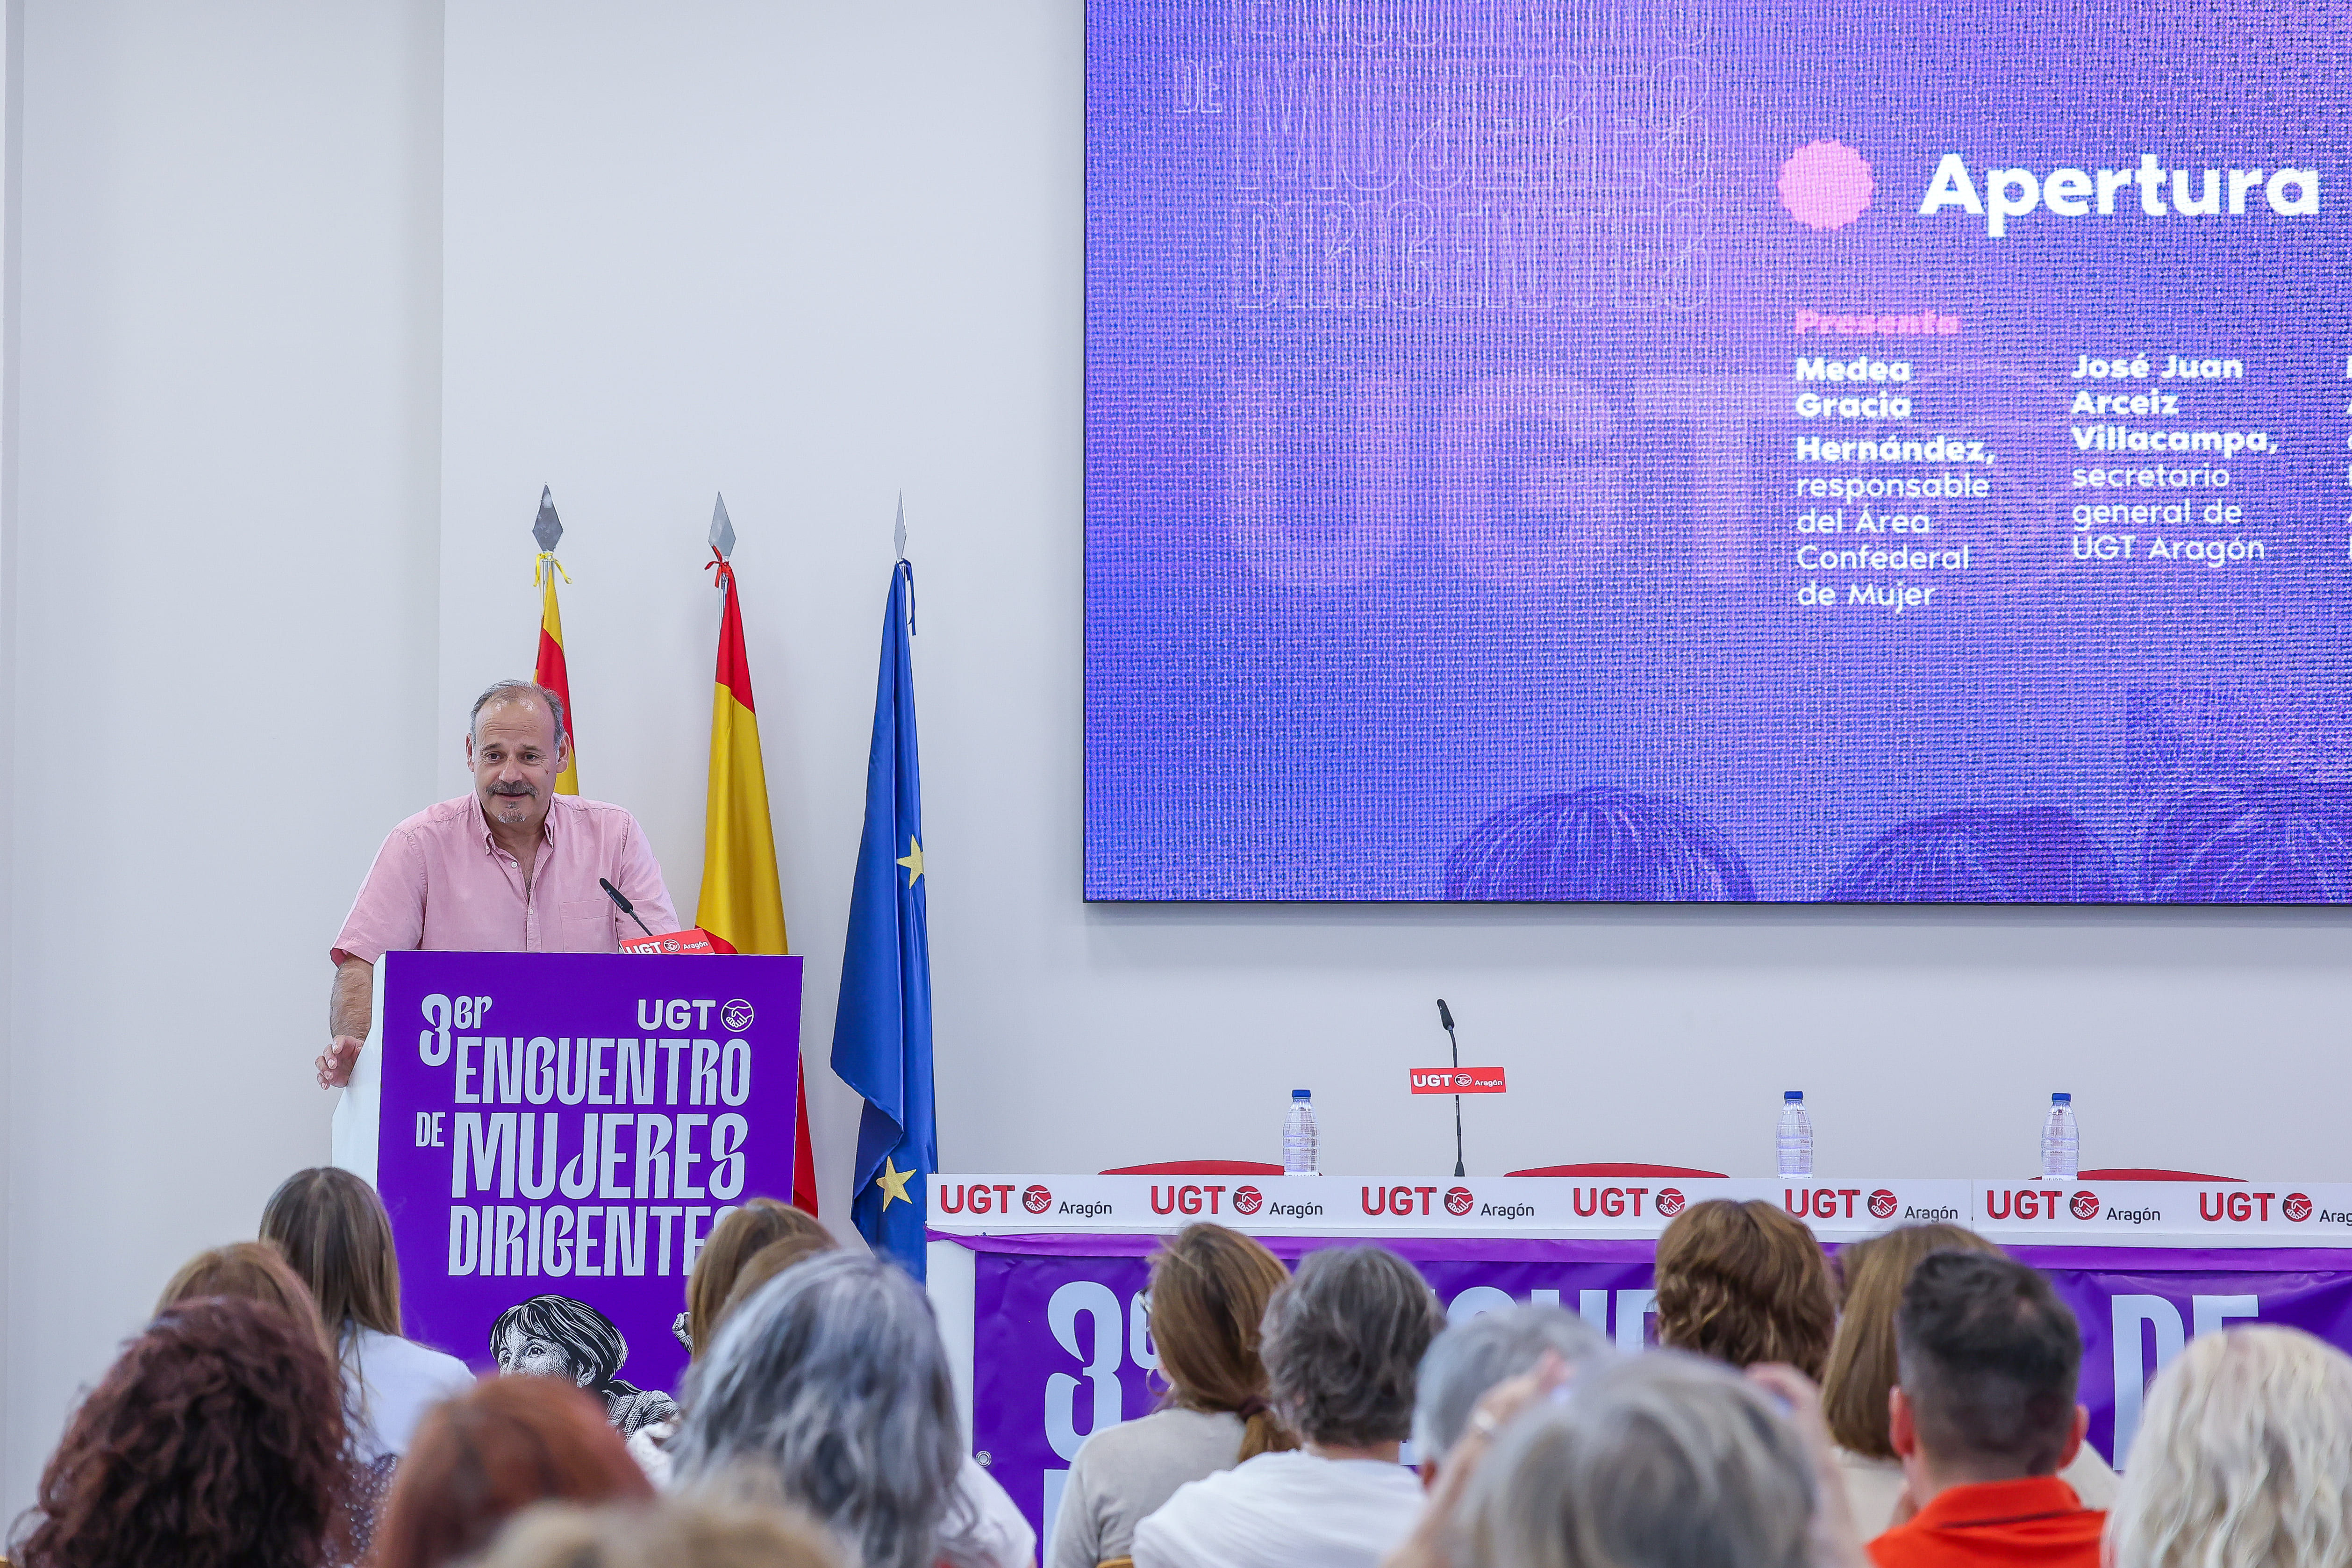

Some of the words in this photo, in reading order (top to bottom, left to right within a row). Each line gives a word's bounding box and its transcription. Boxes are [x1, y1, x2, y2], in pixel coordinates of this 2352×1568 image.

[1176, 59, 1222, 113] DE
[1236, 57, 1710, 191] MUJERES
[1918, 153, 2319, 238] Apertura
[1235, 200, 1710, 309] DIRIGENTES
[1794, 310, 1960, 335] Presenta
[1795, 355, 1911, 382] Medea
[2071, 352, 2150, 379] José
[2161, 354, 2244, 379] Juan
[1794, 389, 1912, 419] Gracia
[2070, 387, 2180, 415] Arceiz
[1796, 434, 1995, 465] Hernández,
[2071, 423, 2279, 459] Villacampa,
[1797, 472, 1990, 505] responsable
[2072, 462, 2230, 488] secretario
[1797, 508, 1843, 534] del
[1855, 503, 1930, 534] Área
[2072, 498, 2191, 532] general
[2203, 499, 2243, 524] de
[1797, 544, 1969, 570] Confederal
[2073, 535, 2136, 560] UGT
[2149, 537, 2265, 568] Aragón
[1797, 580, 1836, 606] de
[1849, 581, 1936, 614] Mujer
[683, 940, 708, 950] Aragón
[637, 999, 716, 1031] UGT
[454, 1036, 751, 1106] ENCUENTRO
[1413, 1074, 1453, 1087] UGT
[415, 1112, 445, 1147] DE
[451, 1112, 749, 1201] MUJERES
[941, 1184, 1015, 1214] UGT
[1058, 1201, 1112, 1218] Aragón
[1151, 1185, 1226, 1215] UGT
[1269, 1202, 1323, 1219] Aragón
[1362, 1186, 1437, 1216] UGT
[1480, 1203, 1534, 1220] Aragón
[1573, 1188, 1648, 1217] UGT
[1785, 1189, 1860, 1218] UGT
[1904, 1206, 1958, 1223] Aragón
[1987, 1190, 2062, 1220] UGT
[2106, 1207, 2160, 1224] Aragón
[2200, 1192, 2275, 1222] UGT
[448, 1205, 739, 1278] DIRIGENTE
